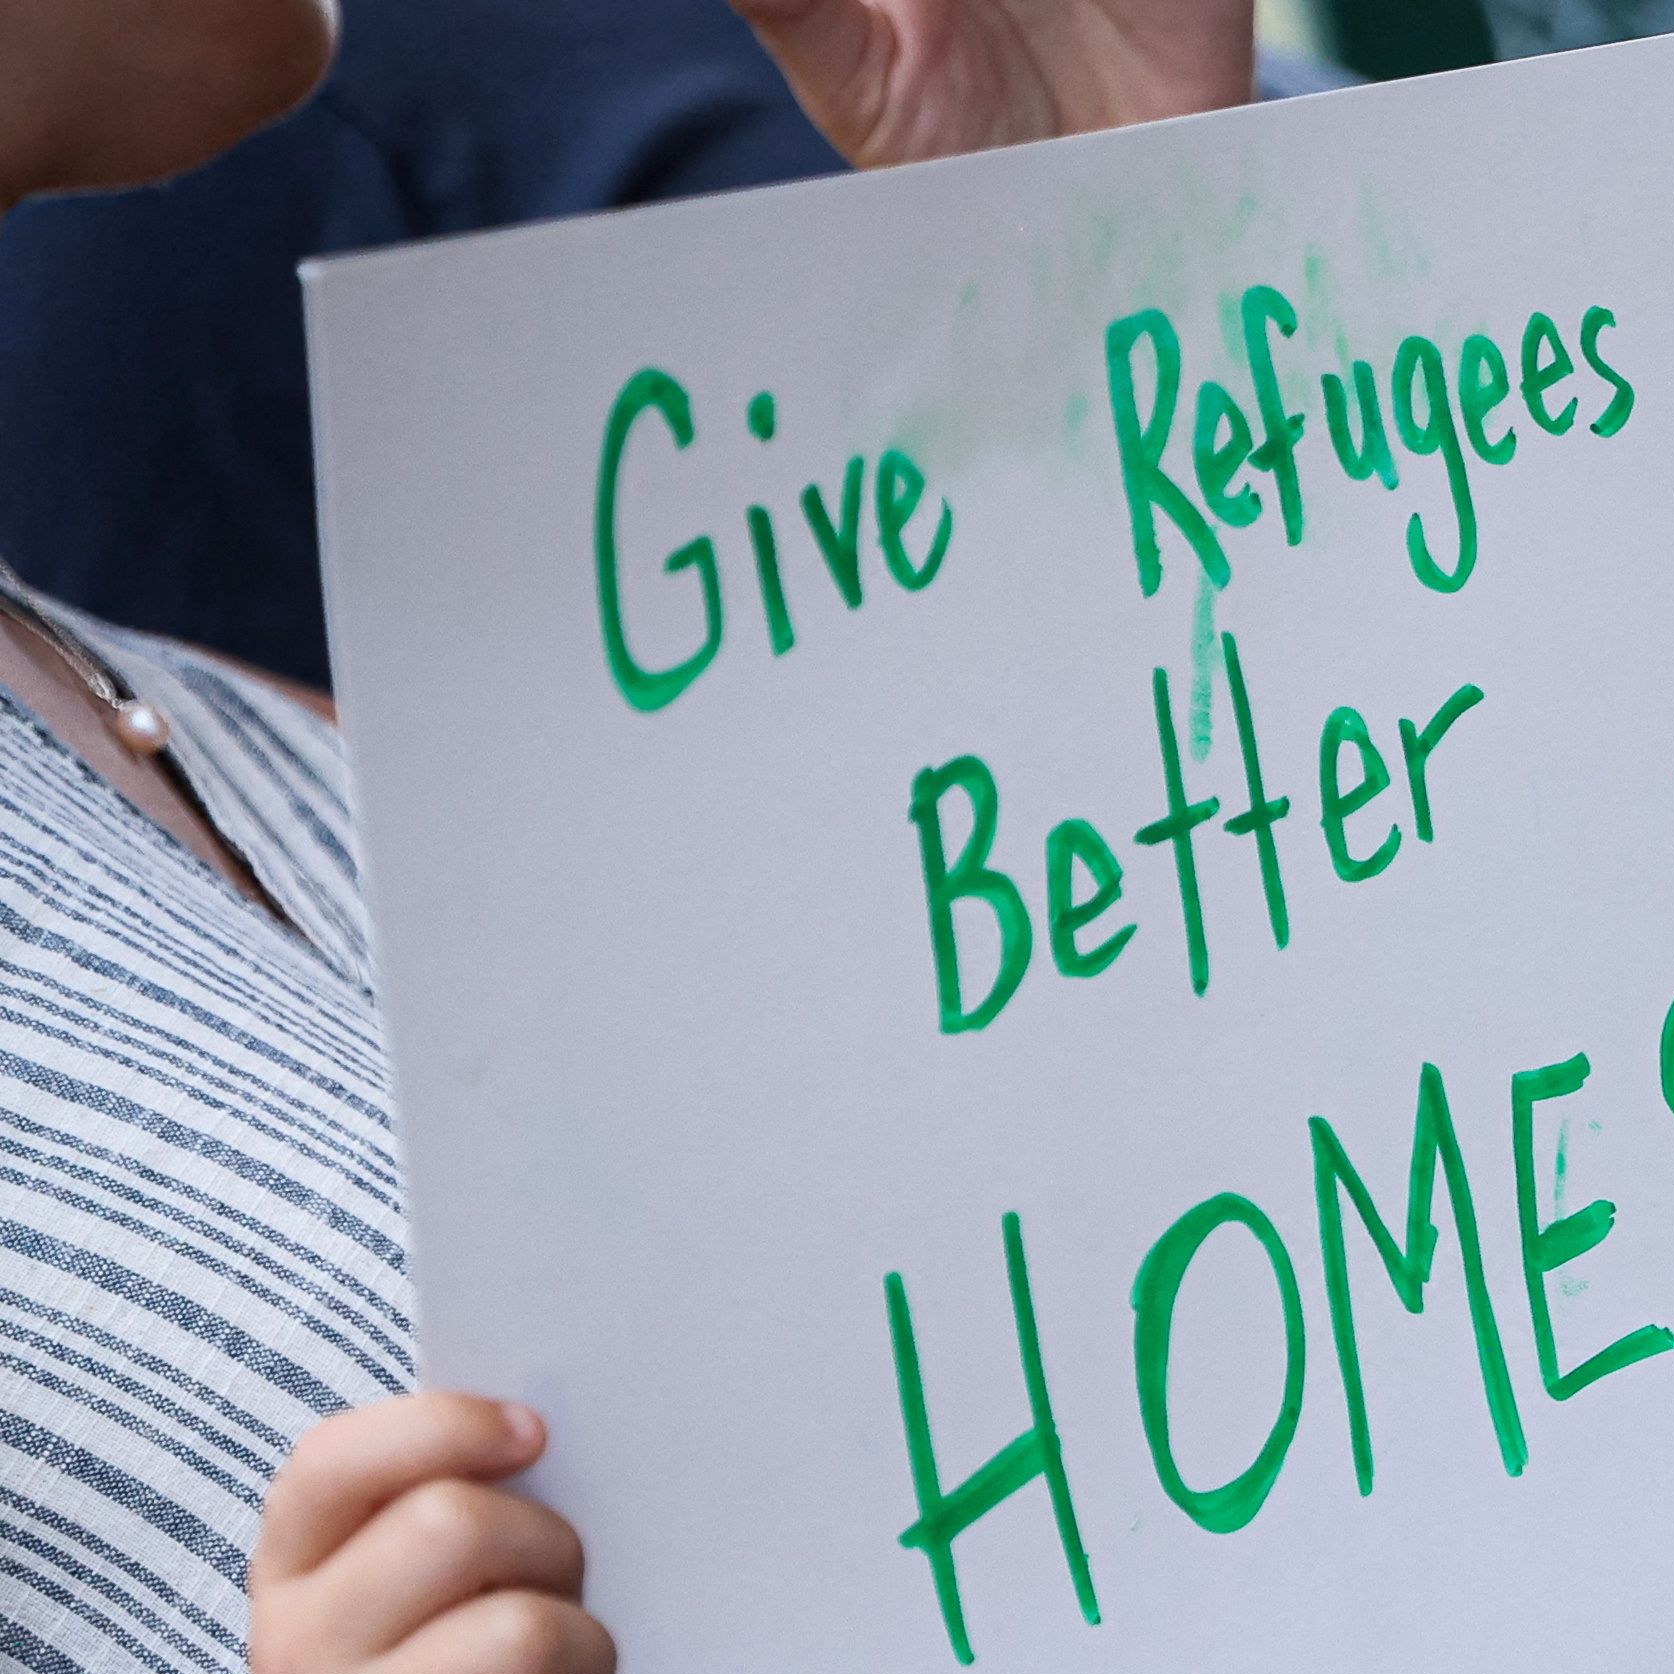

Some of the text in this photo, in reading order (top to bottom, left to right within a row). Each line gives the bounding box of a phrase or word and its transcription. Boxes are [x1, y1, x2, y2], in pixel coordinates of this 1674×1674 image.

[592, 284, 1637, 716] Give Refugees
[908, 630, 1487, 1037] Better
